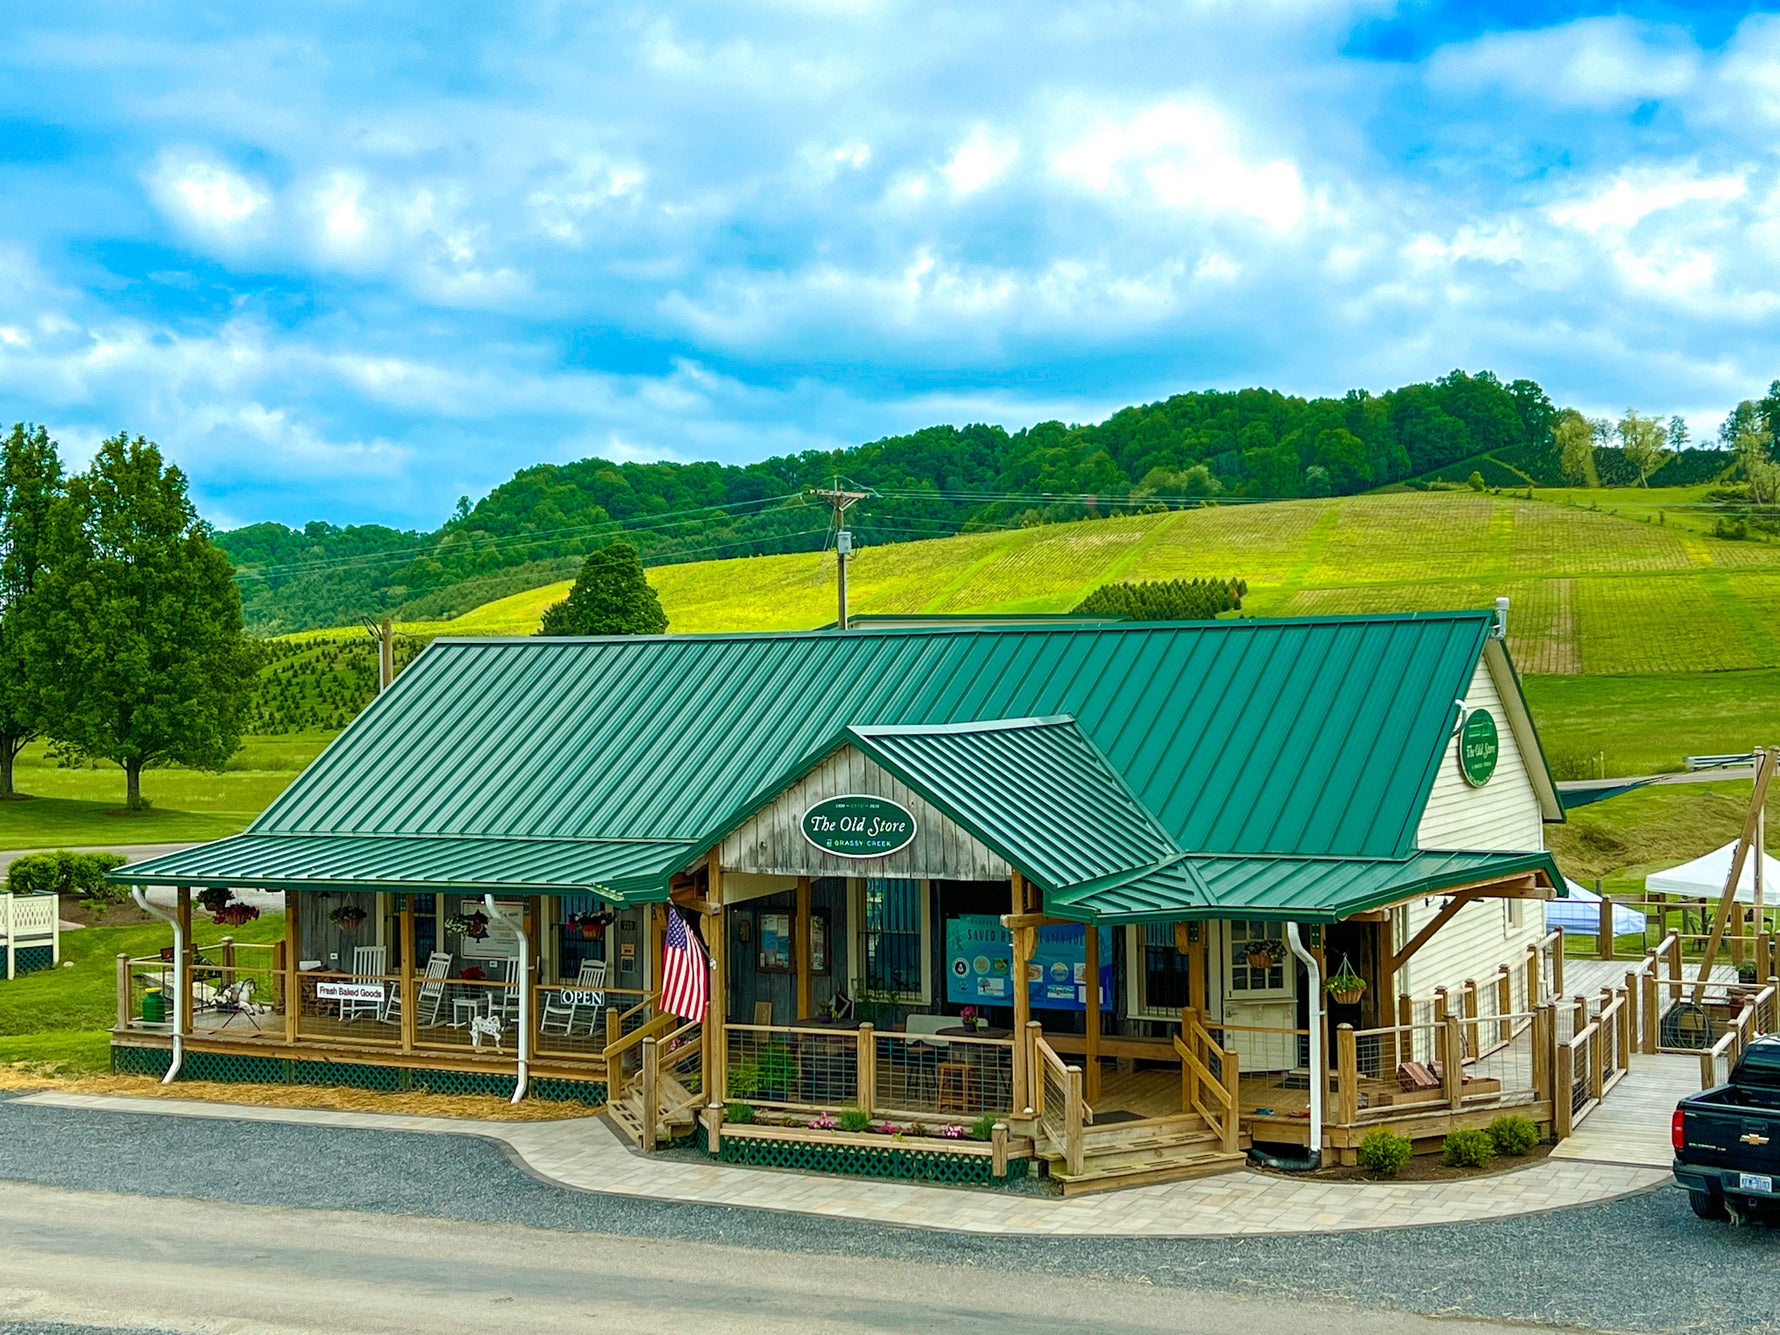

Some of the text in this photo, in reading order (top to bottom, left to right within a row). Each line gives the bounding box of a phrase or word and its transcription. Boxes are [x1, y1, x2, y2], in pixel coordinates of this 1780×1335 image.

[811, 814, 906, 837] The Old Store
[967, 928, 997, 942] SAVED
[319, 986, 382, 998] Fresh Baked Goods
[562, 990, 603, 1005] OPEN
